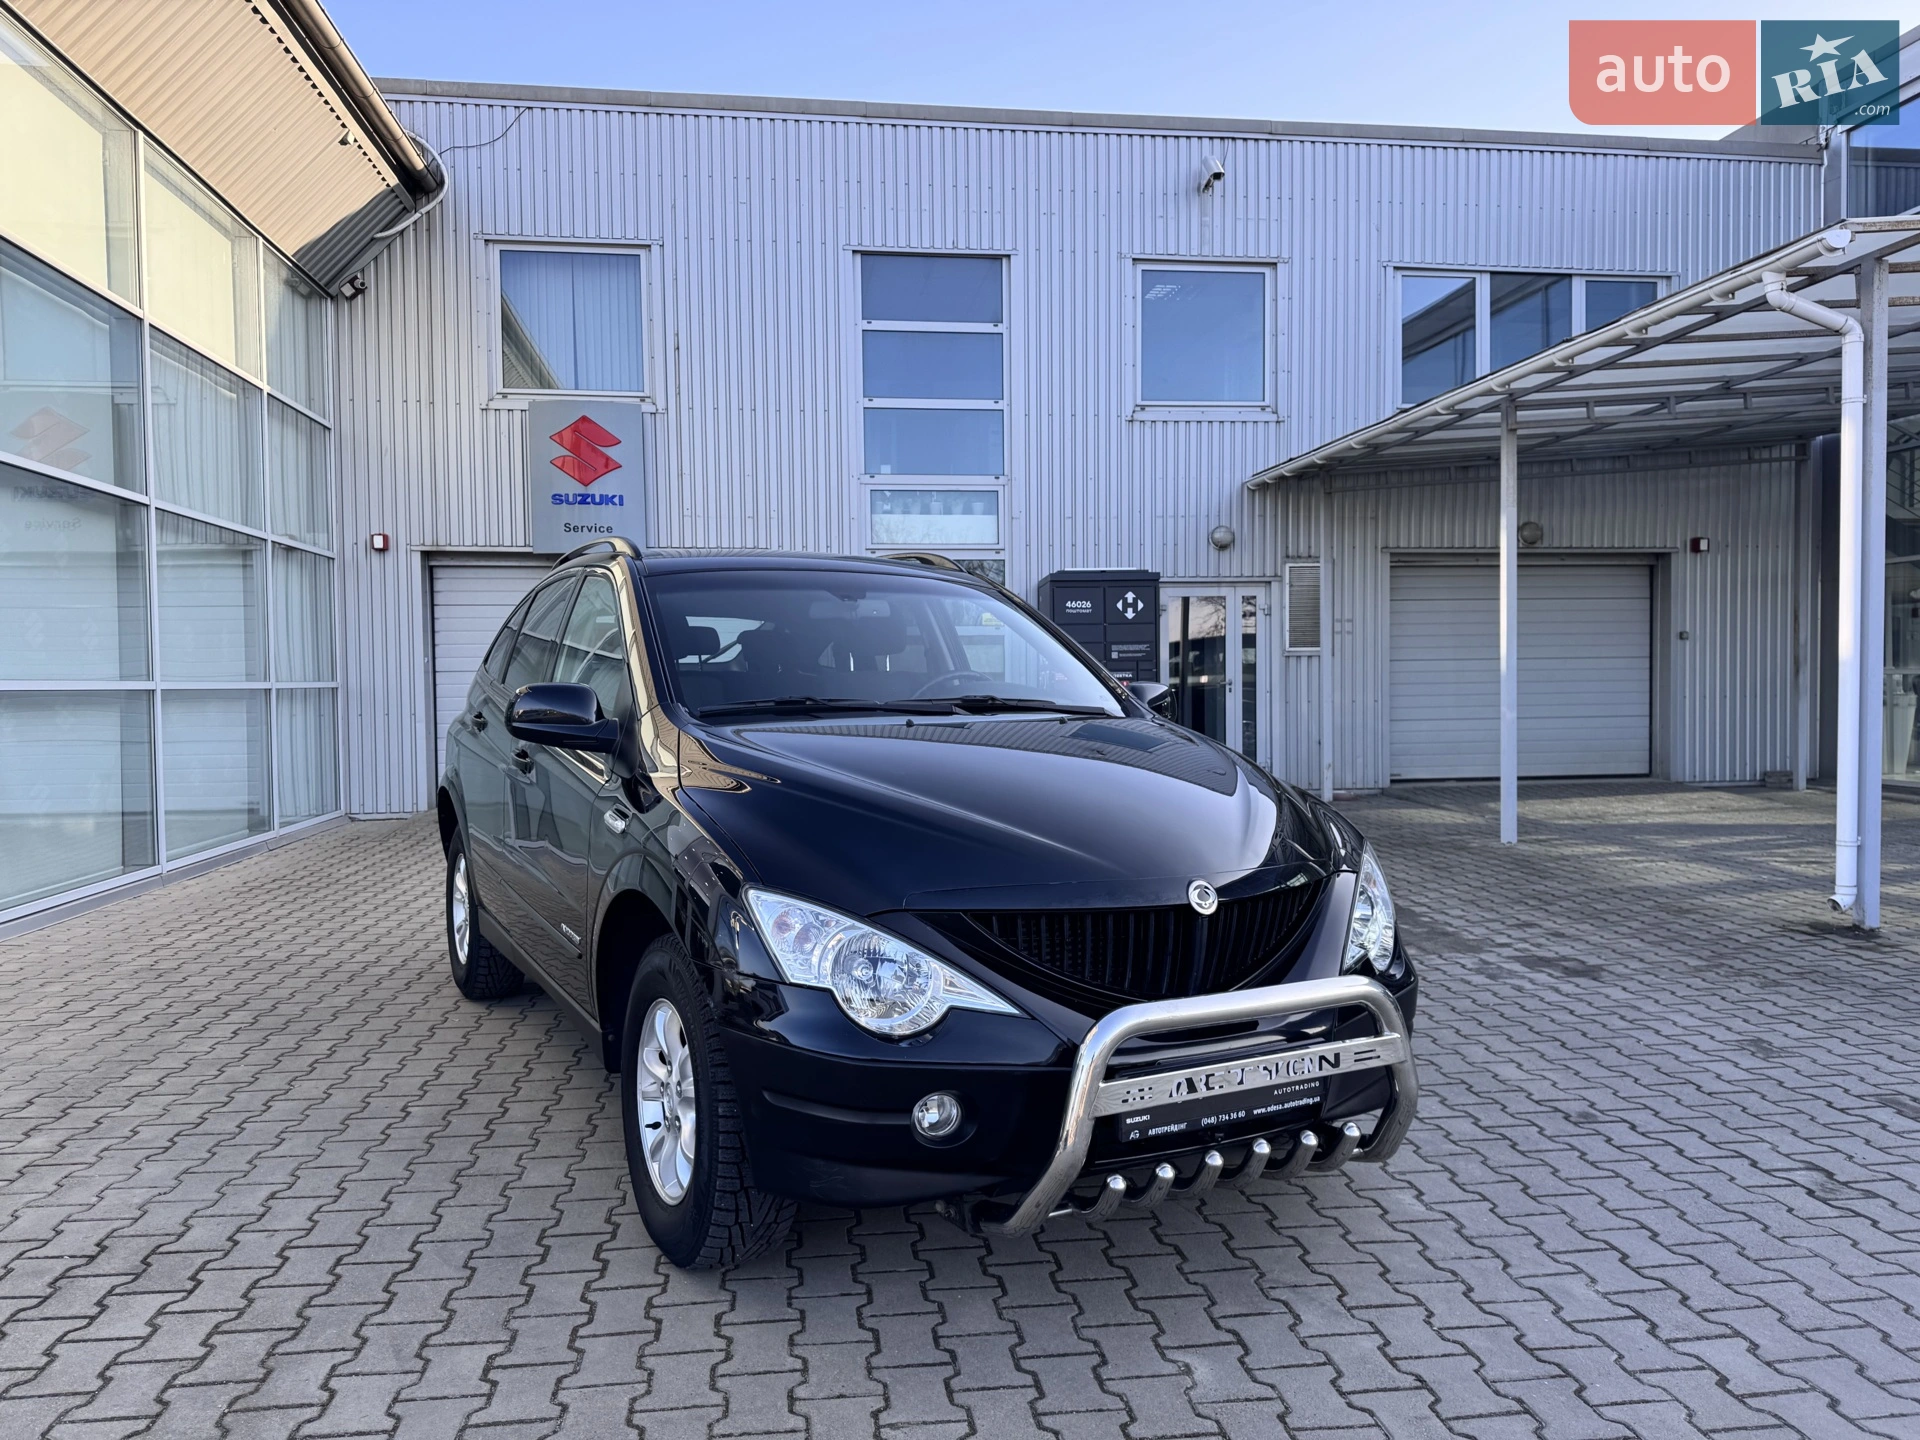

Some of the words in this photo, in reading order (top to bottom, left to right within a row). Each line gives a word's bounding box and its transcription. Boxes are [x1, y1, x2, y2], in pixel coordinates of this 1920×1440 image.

[551, 493, 624, 506] SUZUKI
[563, 522, 614, 533] Service
[1065, 600, 1092, 609] 46026
[1273, 1081, 1320, 1095] AUTOTRADING
[1125, 1114, 1151, 1124] SUZUKI
[1201, 1115, 1218, 1127] (048)
[1218, 1112, 1229, 1122] 734
[1229, 1110, 1238, 1120] 36
[1238, 1109, 1246, 1118] 60
